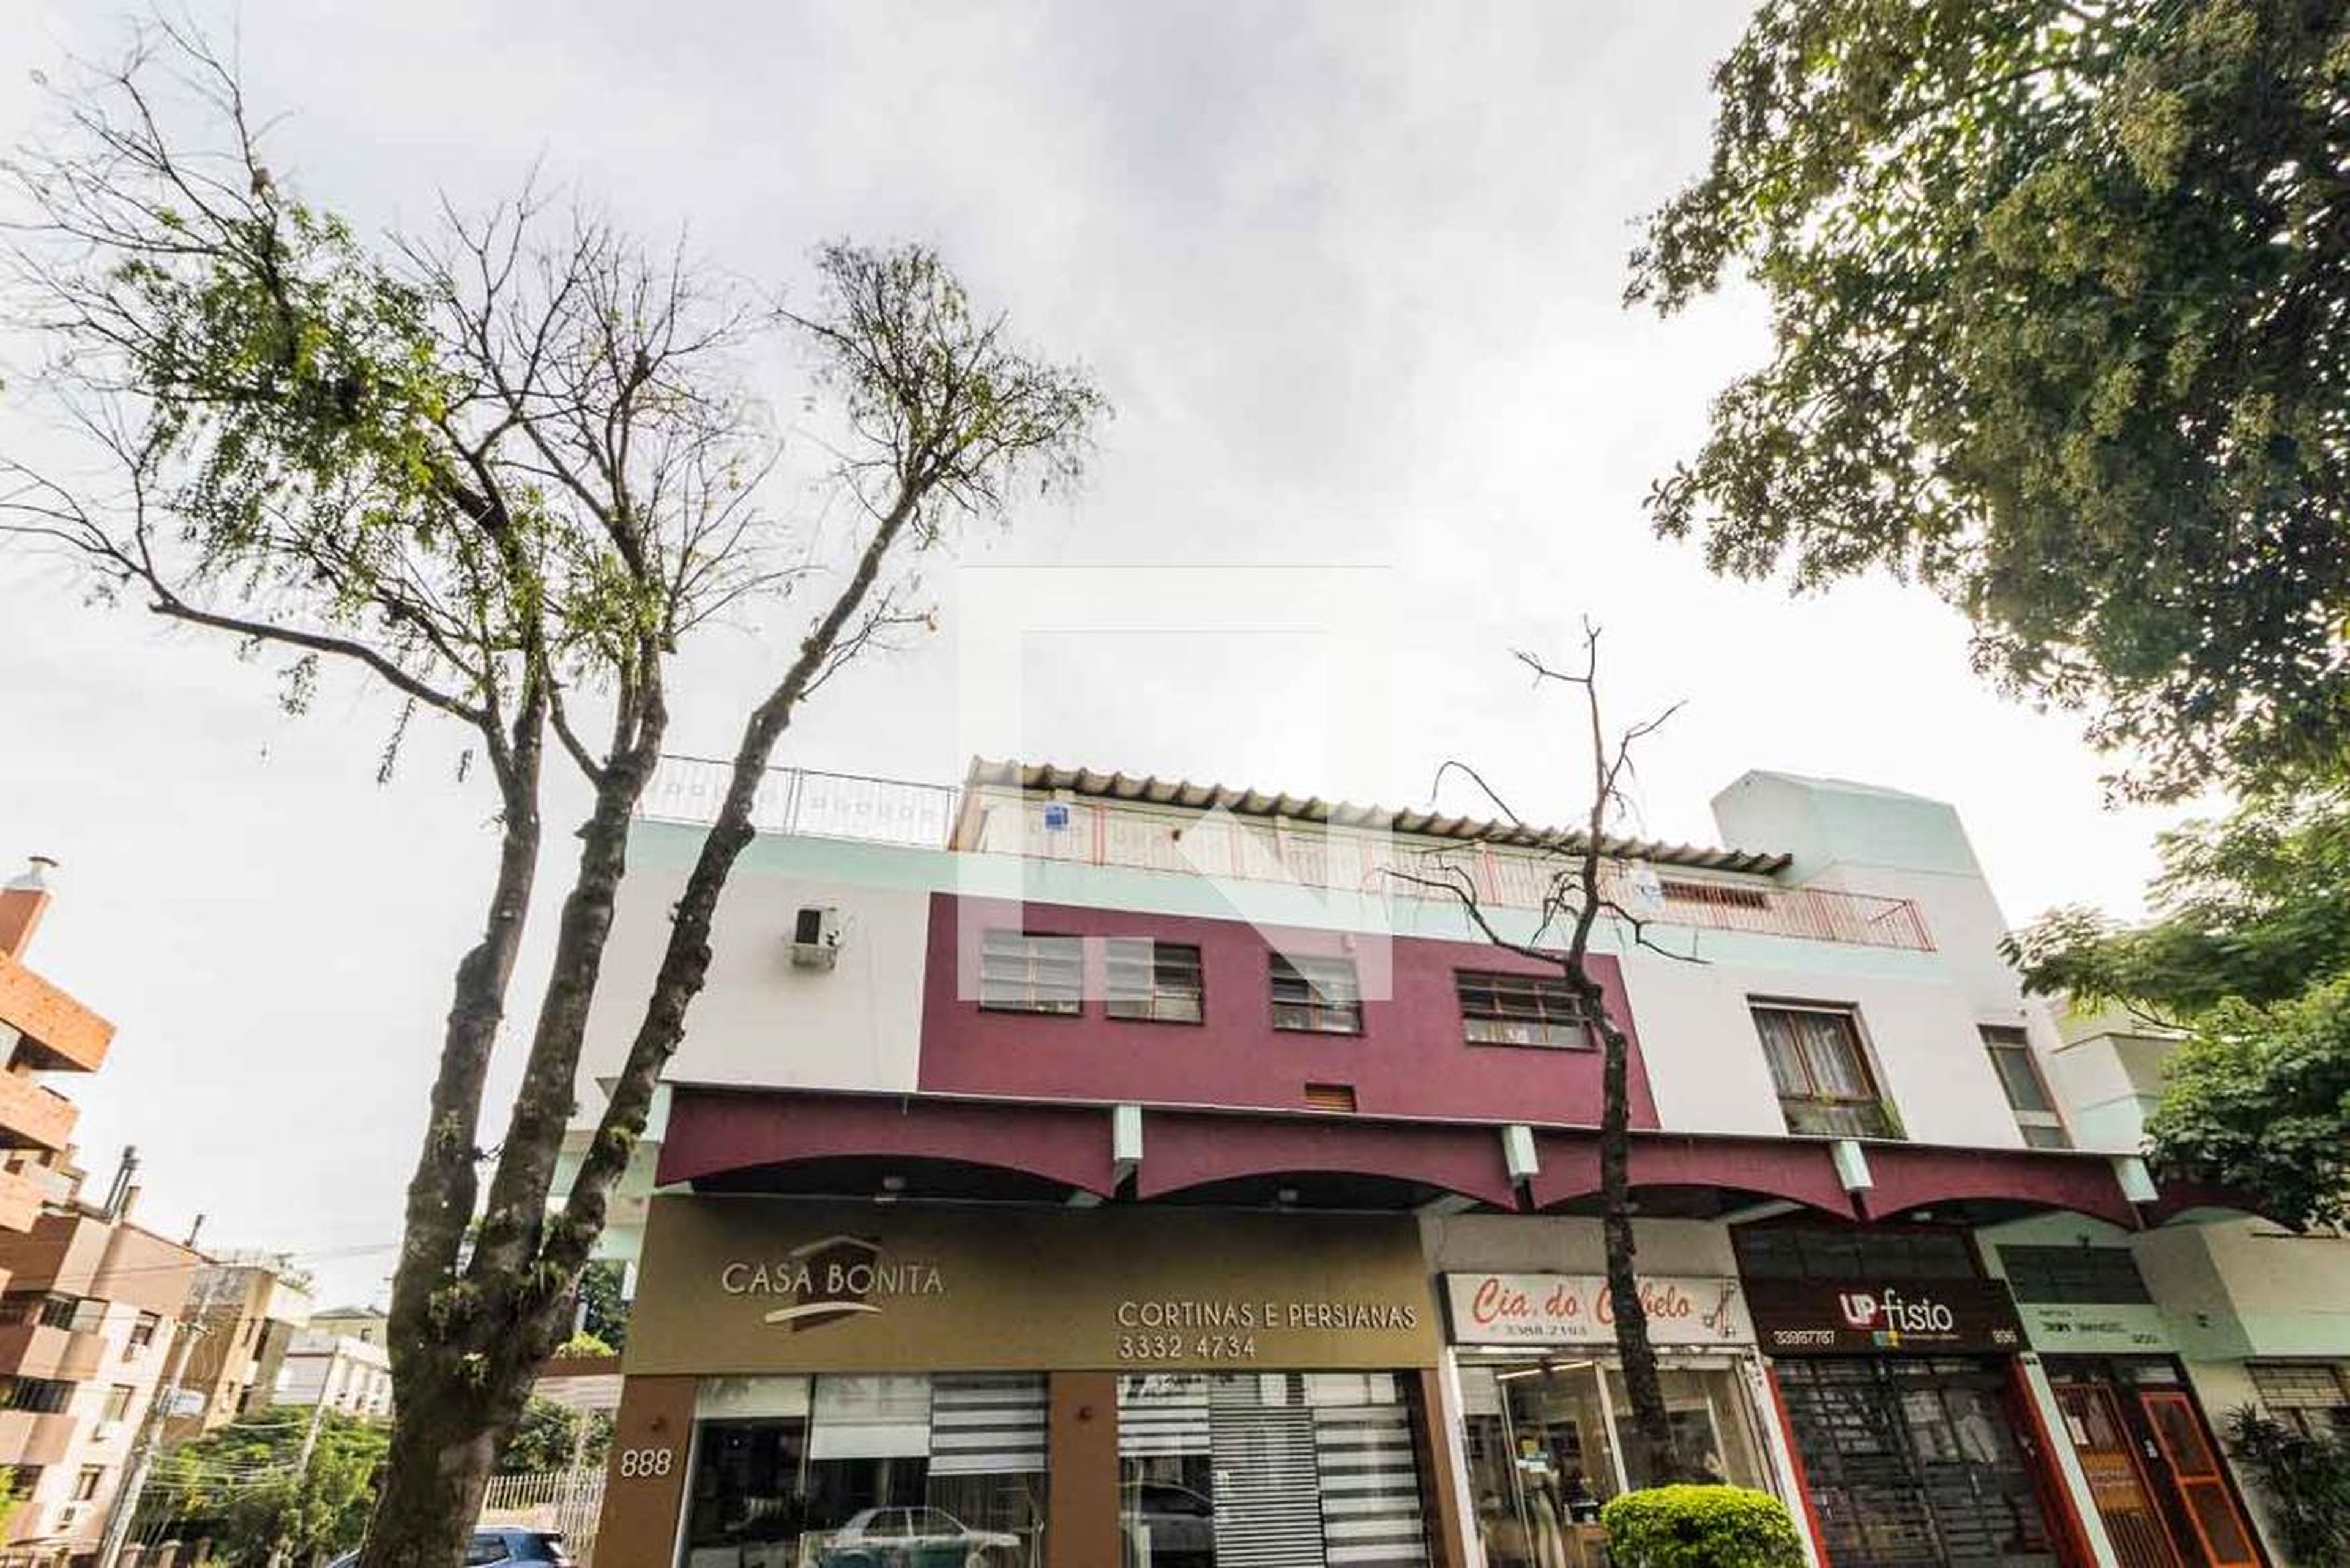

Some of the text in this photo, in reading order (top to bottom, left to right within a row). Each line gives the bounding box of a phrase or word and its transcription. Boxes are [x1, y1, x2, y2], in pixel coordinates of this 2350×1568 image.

[722, 1262, 944, 1294] CASA BONITA
[1117, 1301, 1417, 1328] CORTINAS E PERSIANAS
[1545, 1284, 1577, 1316] do
[1596, 1283, 1690, 1324] Cbelo
[1119, 1335, 1256, 1359] 3332 4734
[622, 1449, 672, 1476] 888
